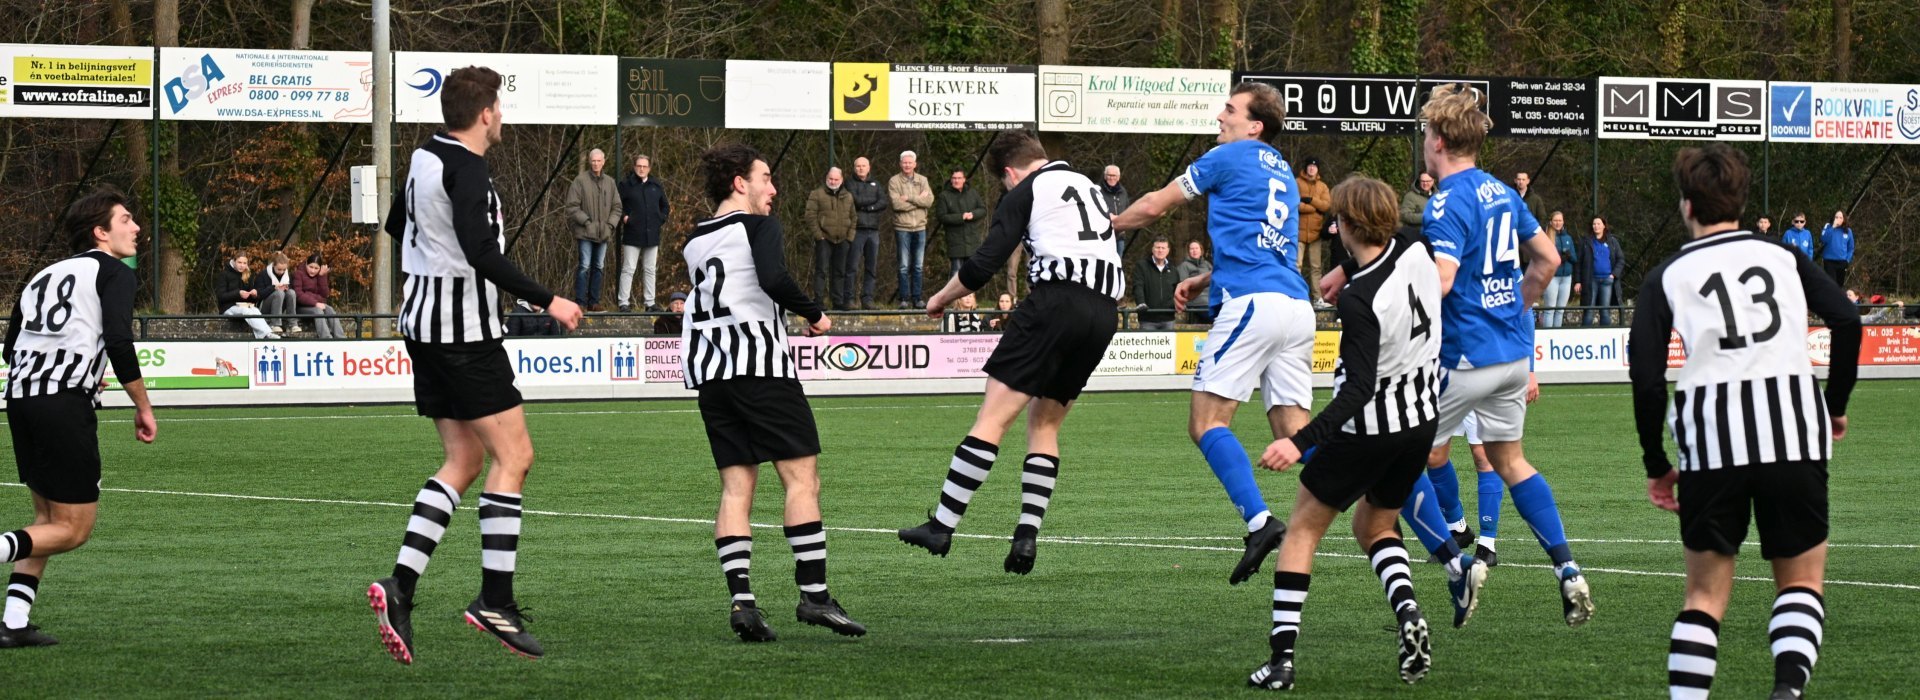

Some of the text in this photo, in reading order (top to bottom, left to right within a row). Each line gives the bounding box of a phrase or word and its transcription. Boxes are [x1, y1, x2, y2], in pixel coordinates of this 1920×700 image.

[30, 61, 46, 69] Nr.
[56, 62, 66, 70] in
[69, 62, 136, 72] belijningsverf
[30, 72, 136, 82] én voetbalmaterialen!
[164, 53, 226, 115] DSA
[249, 75, 312, 86] BEL GRATIS
[627, 68, 668, 90] BRIL
[908, 78, 1000, 94] HEKWERK
[1088, 75, 1226, 96] Krol Witgoed Service
[1511, 81, 1528, 90] Plein
[1545, 82, 1560, 90] Zuid
[1562, 82, 1586, 91] 32-34
[22, 90, 143, 104] www.rofraline.nl
[207, 82, 244, 104] EXPRESS
[249, 90, 278, 100] 0800
[290, 91, 312, 101] 099
[316, 92, 330, 101] 77
[335, 92, 350, 102] 88
[1546, 98, 1567, 106] Soest
[217, 108, 323, 118] WWW.DSA-EXPRESS.NL
[629, 93, 692, 116] STUDIO
[908, 99, 964, 116] SOEST
[1107, 99, 1144, 110] Reparatie
[1163, 100, 1177, 110] alle
[1180, 101, 1208, 110] merken
[1815, 98, 1893, 117] ROOKVRIJE
[1511, 111, 1523, 119] Tel.
[1548, 112, 1584, 120] 6014014
[1341, 122, 1386, 132] SLIJTERIJ
[1772, 125, 1810, 135] ROOKVRIJ
[1815, 120, 1893, 138] GENERATIE
[1266, 177, 1289, 230] 6
[1061, 186, 1113, 241] 19
[1260, 222, 1290, 247] Your
[1482, 212, 1520, 275] 14
[692, 257, 732, 323] 12
[25, 272, 76, 332] 18
[1698, 266, 1781, 350] 13
[1408, 282, 1431, 341] 4
[1867, 328, 1878, 336] Tel.
[1881, 328, 1893, 336] 035
[868, 345, 930, 369] ZUID
[1108, 350, 1172, 360] & Onderhoud
[1550, 338, 1616, 360] hoes.nl
[294, 352, 334, 376] Lift
[518, 349, 602, 374] hoes.nl
[1313, 358, 1334, 371] zijn!
